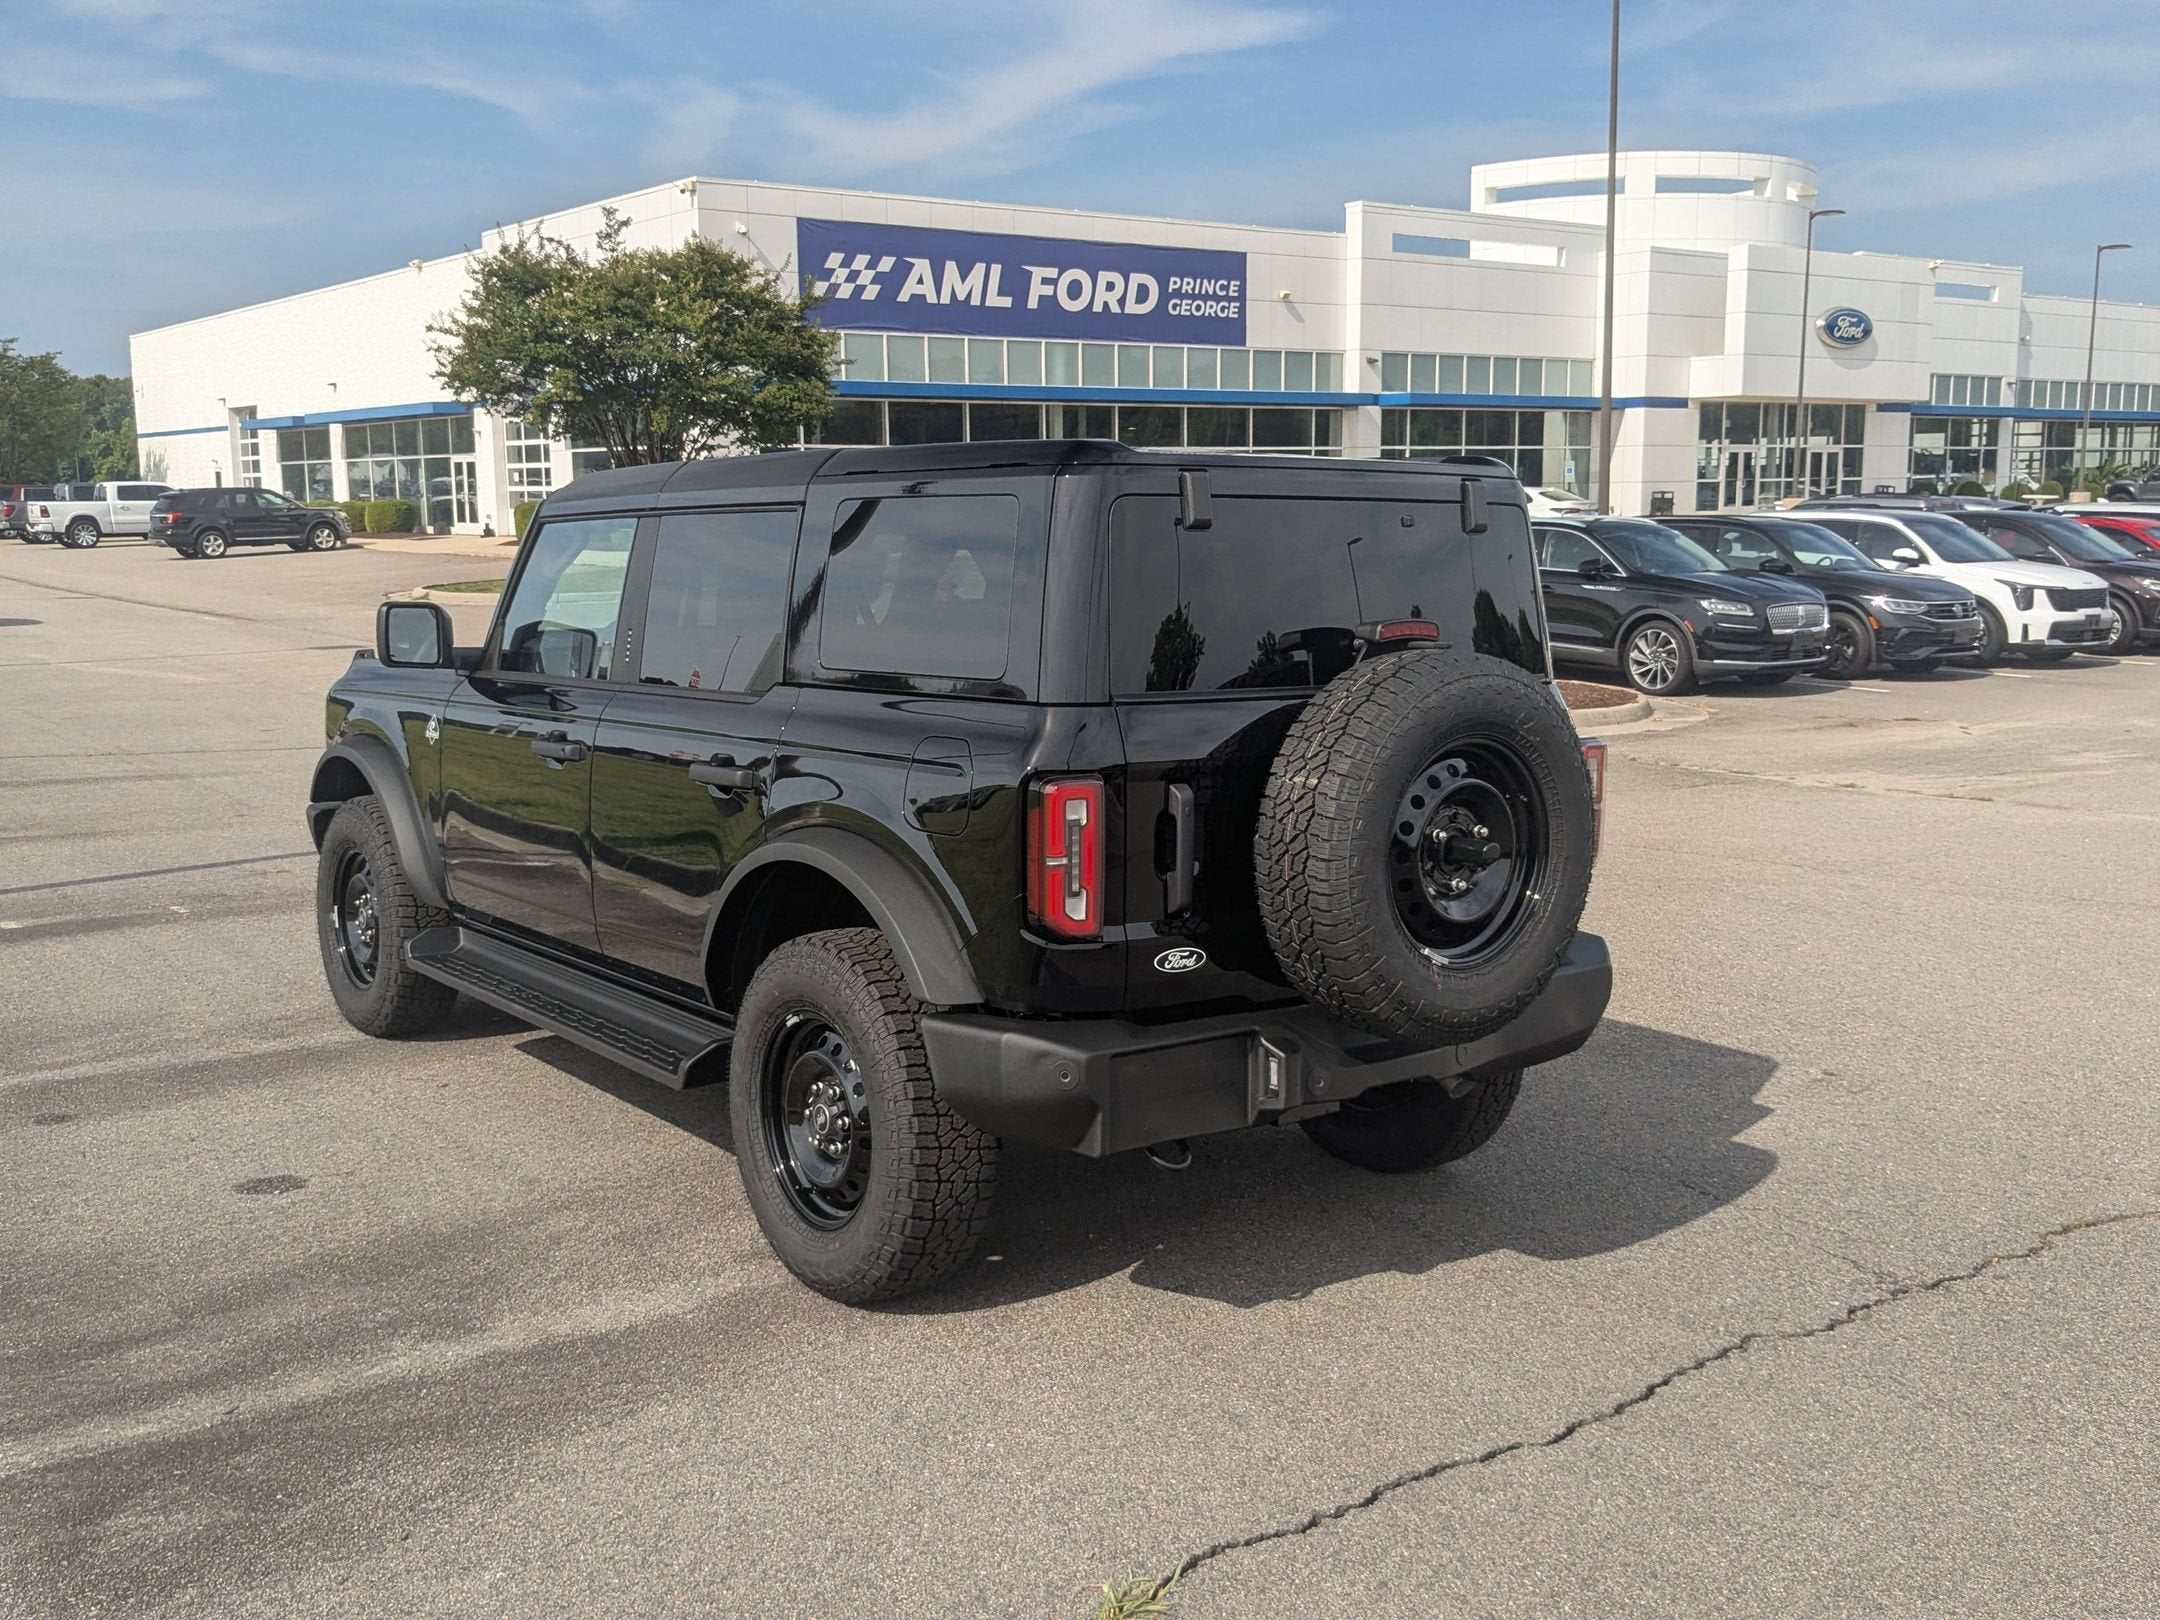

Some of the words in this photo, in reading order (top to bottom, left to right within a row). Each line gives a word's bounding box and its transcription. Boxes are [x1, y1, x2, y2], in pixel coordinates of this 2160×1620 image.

[897, 257, 1013, 308] AML
[1021, 264, 1160, 315] FORD
[1167, 276, 1240, 298] PRINCE
[1167, 298, 1240, 319] GEORGE
[1833, 315, 1865, 338] Ford
[1164, 951, 1198, 969] Ford
